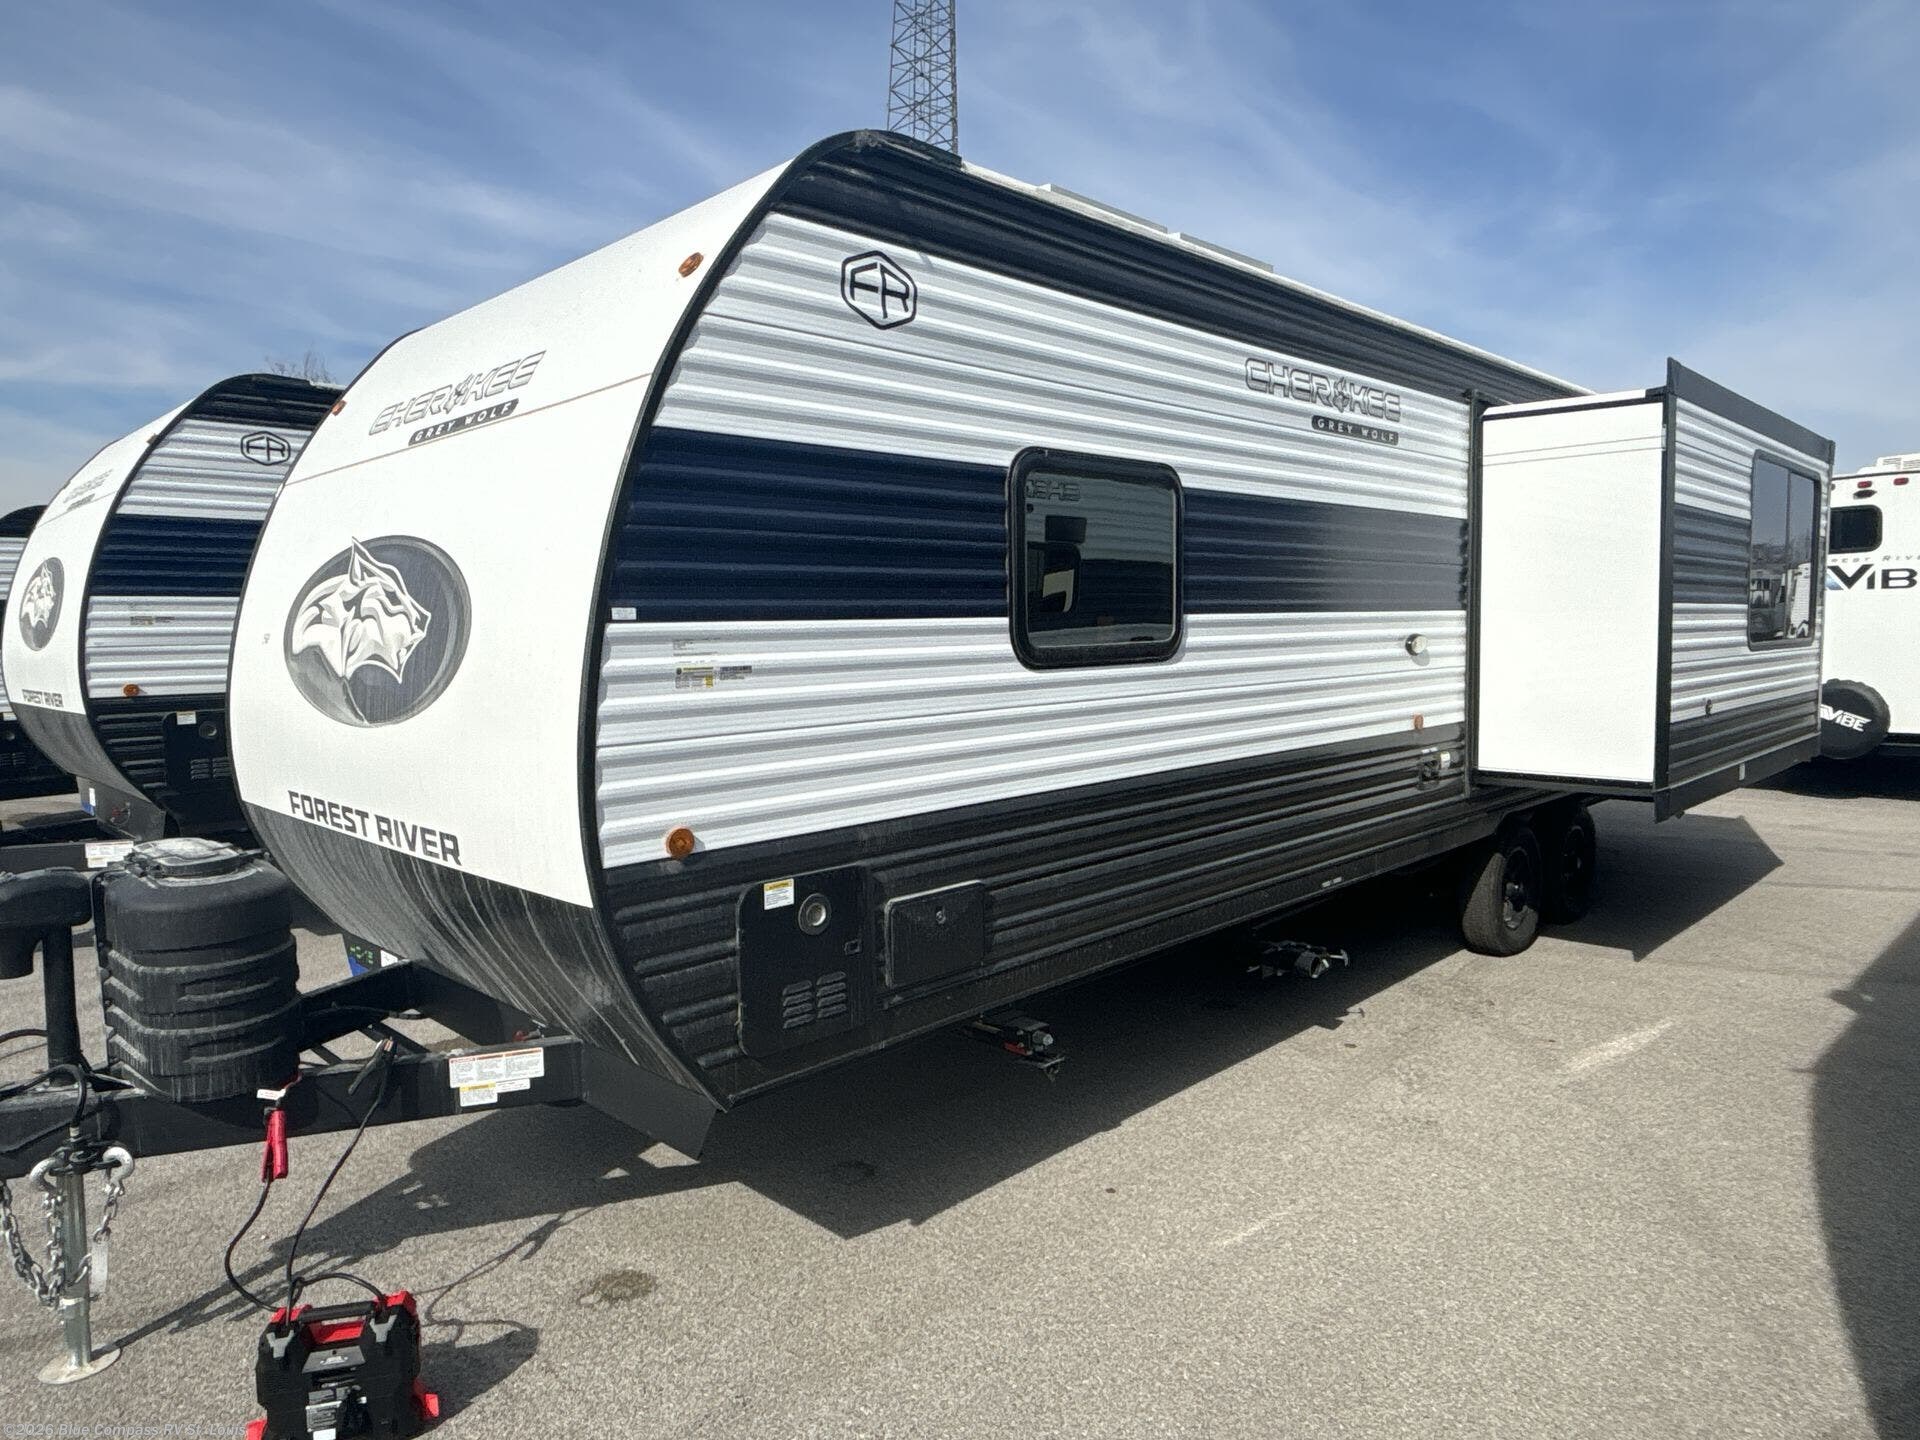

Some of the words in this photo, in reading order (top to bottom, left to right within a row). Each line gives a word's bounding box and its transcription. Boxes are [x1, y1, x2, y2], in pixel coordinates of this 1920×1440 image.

[1244, 357, 1401, 424] CHEROKEE
[414, 423, 454, 442] GREY
[464, 402, 513, 425] WOLF
[1316, 418, 1354, 435] GREY
[1361, 428, 1396, 443] WOLF
[1827, 563, 1919, 591] VIB
[287, 789, 370, 838] FOREST
[374, 814, 462, 867] RIVER
